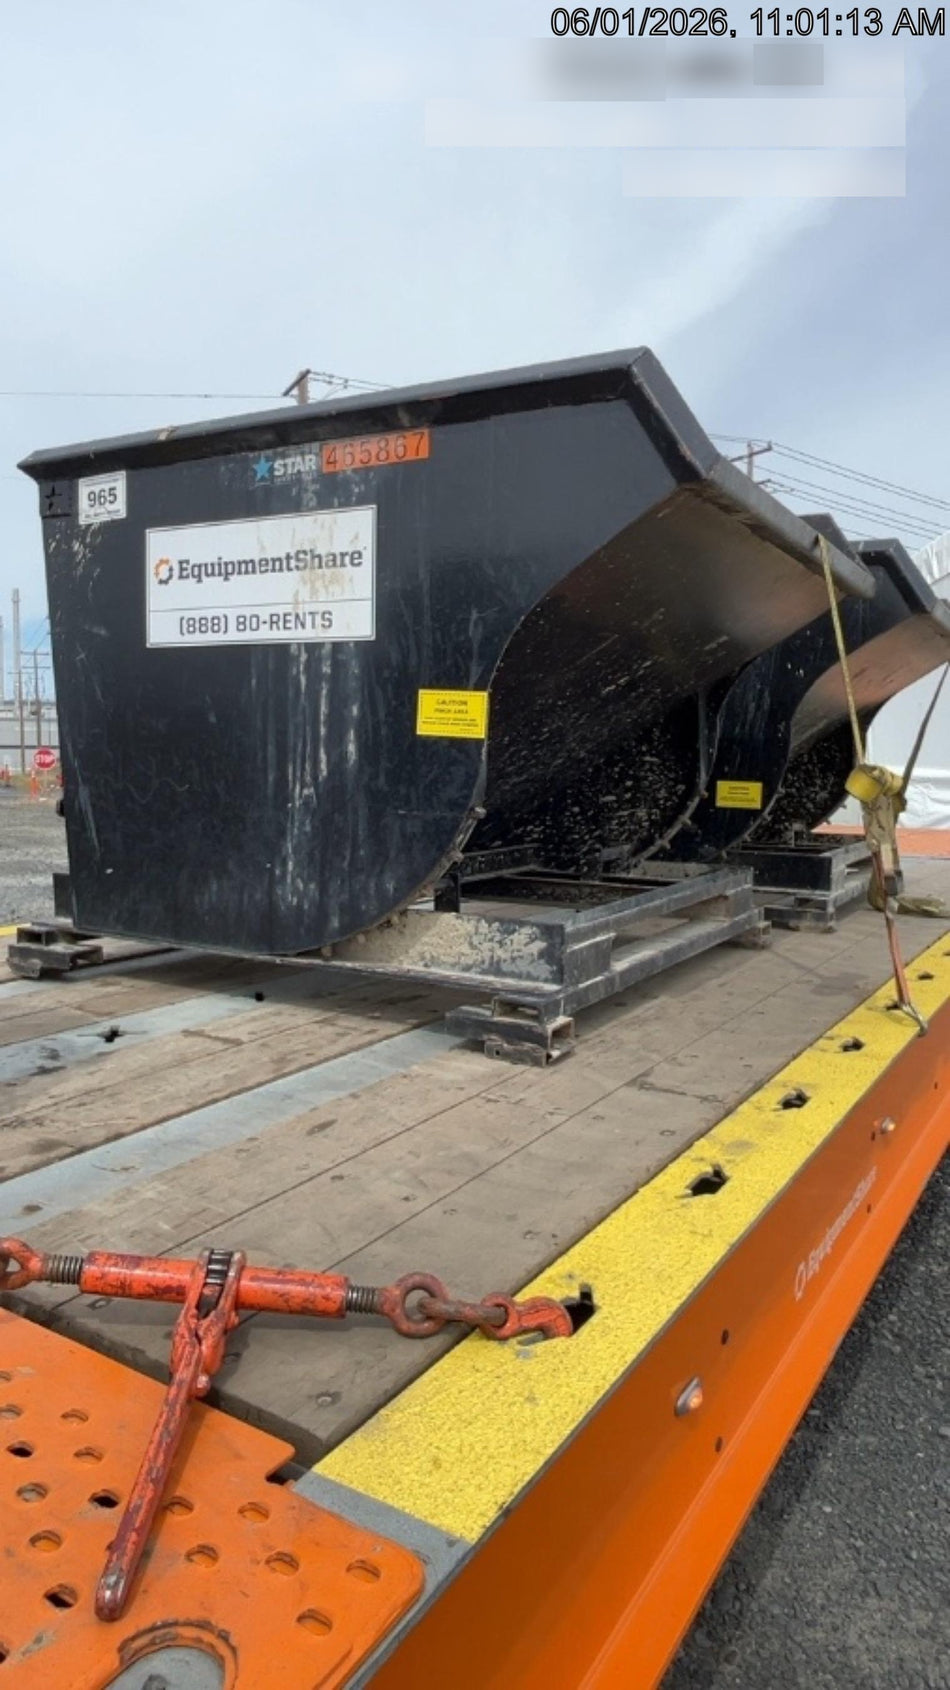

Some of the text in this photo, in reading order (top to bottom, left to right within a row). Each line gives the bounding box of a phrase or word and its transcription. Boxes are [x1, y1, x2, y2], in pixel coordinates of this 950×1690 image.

[326, 431, 425, 470] 465867
[273, 454, 317, 477] STAR
[87, 486, 118, 508] 965
[177, 549, 364, 584] EquipmentShare
[179, 610, 334, 636] (888) 80-RENTS
